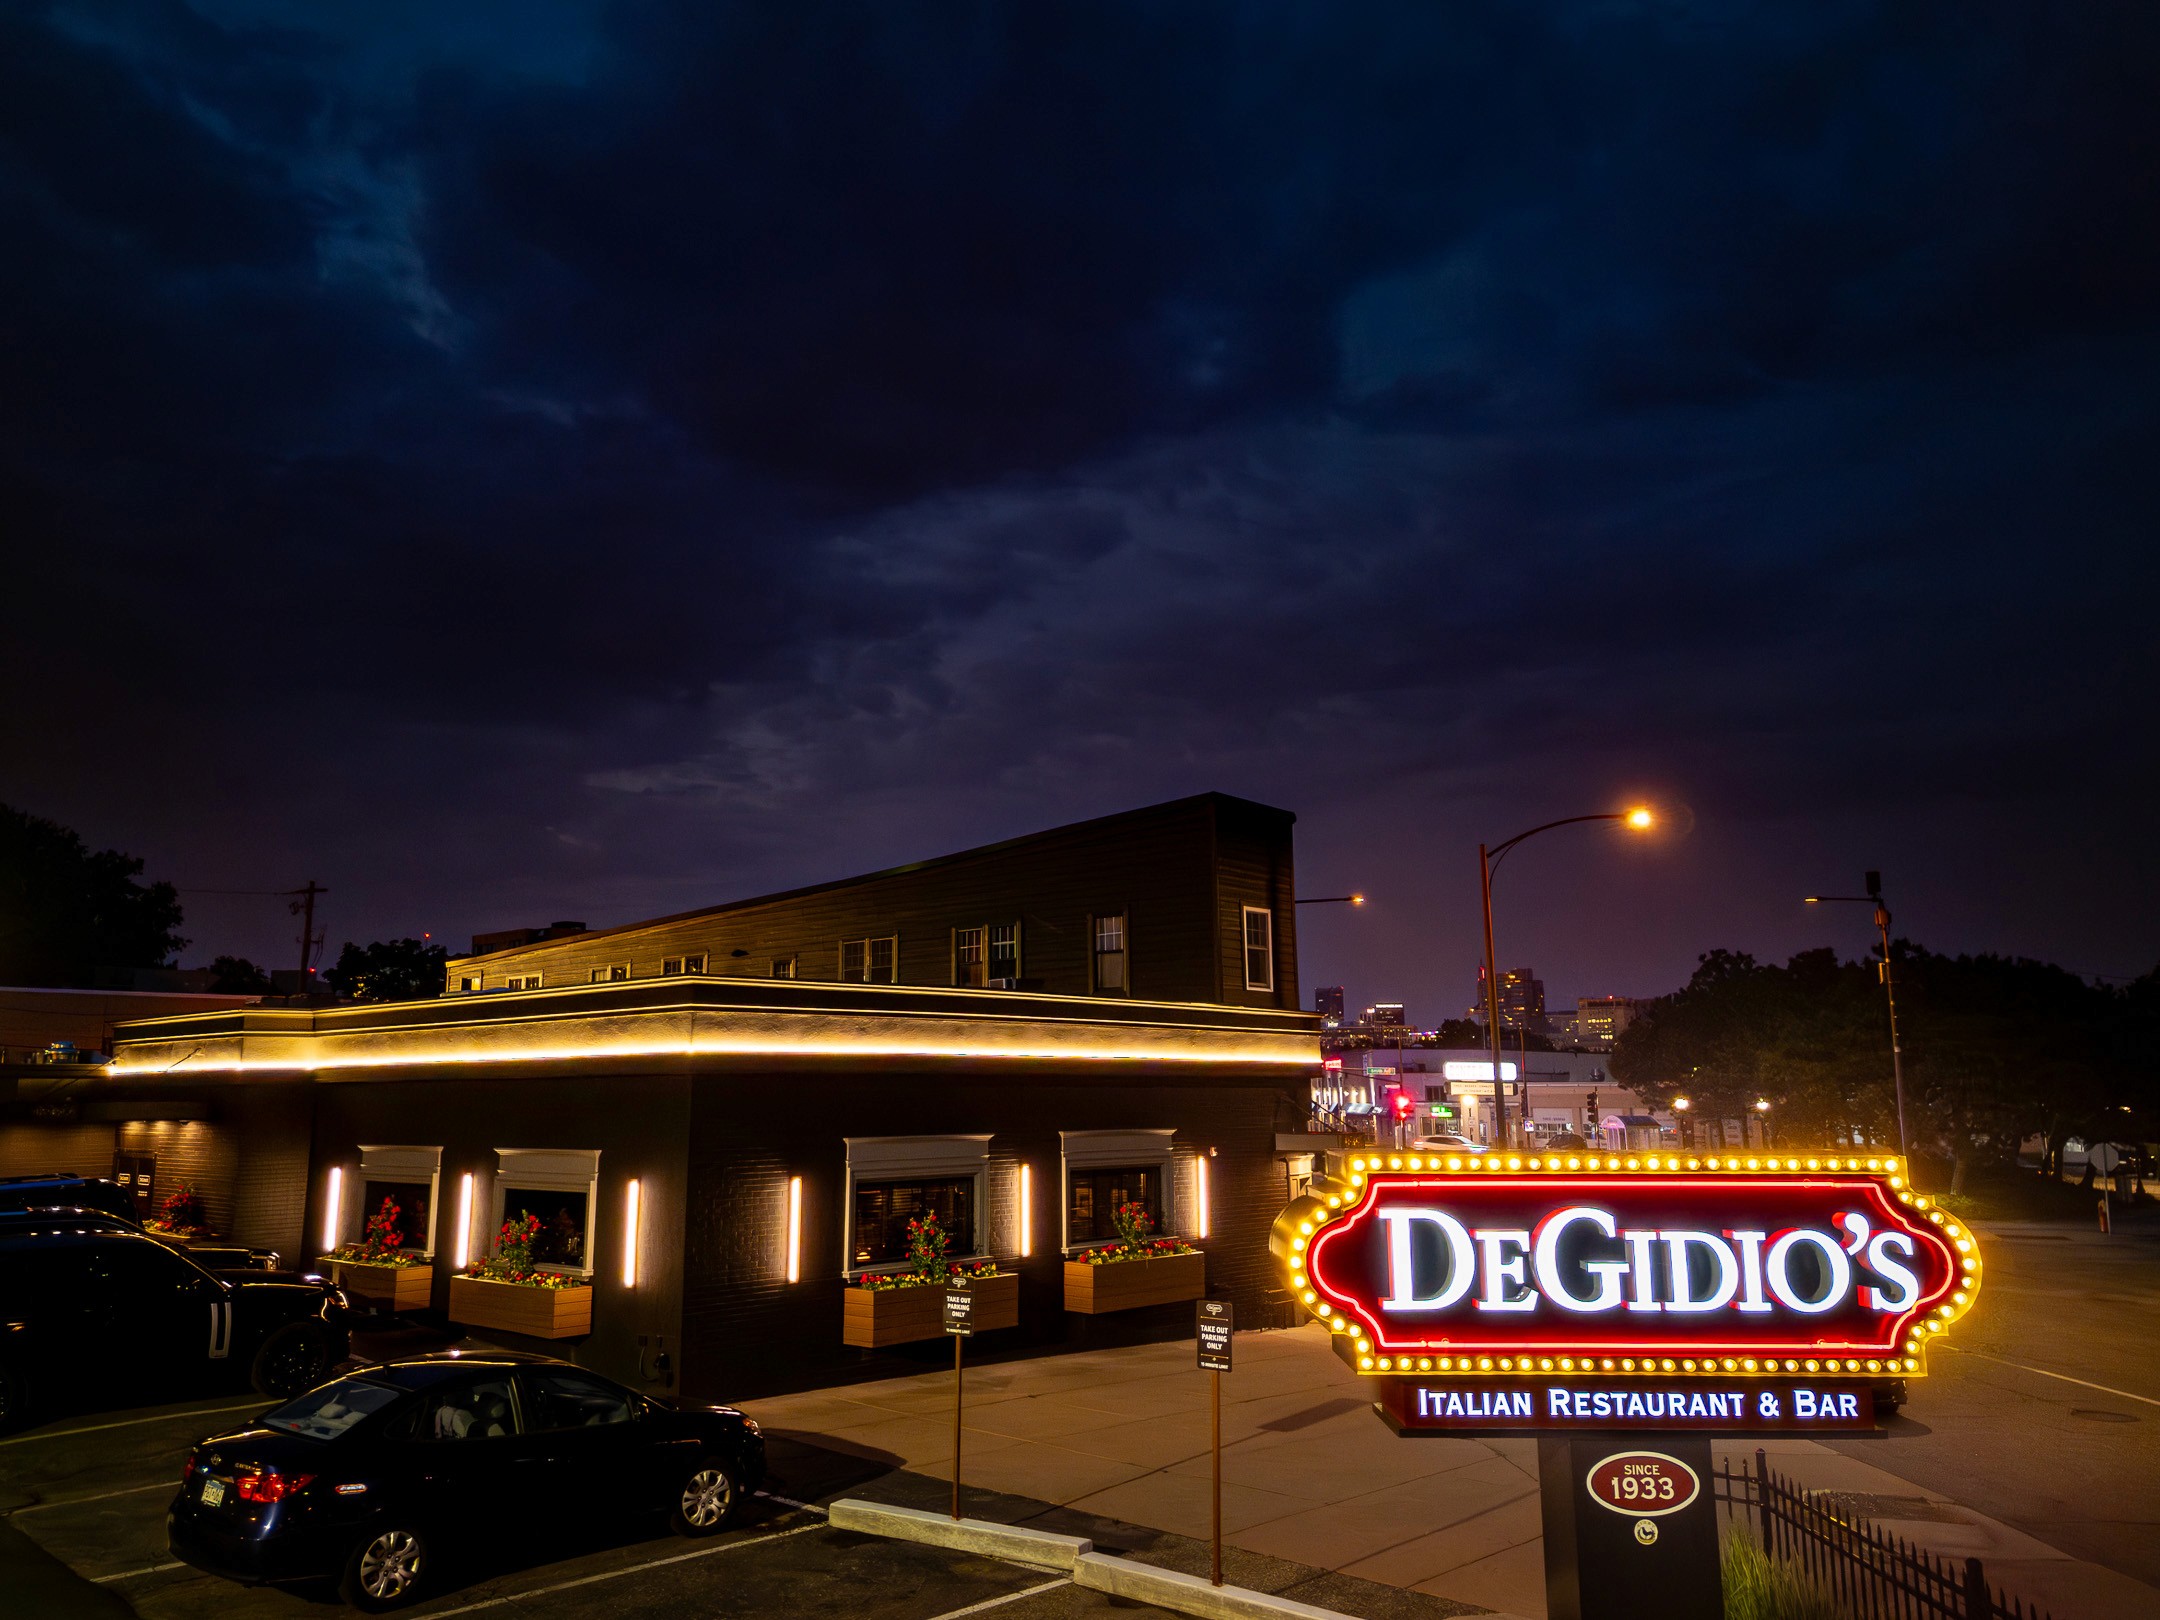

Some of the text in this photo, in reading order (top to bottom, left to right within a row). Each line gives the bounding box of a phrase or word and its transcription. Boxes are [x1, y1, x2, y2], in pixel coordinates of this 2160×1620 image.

[947, 1303, 970, 1311] PARKING
[1200, 1325, 1228, 1335] TAKE OUT
[1201, 1333, 1228, 1343] PARKING
[1206, 1342, 1223, 1350] ONLY
[1758, 1391, 1780, 1418] &
[1623, 1464, 1660, 1476] SINCE
[1610, 1476, 1675, 1501] 1933
